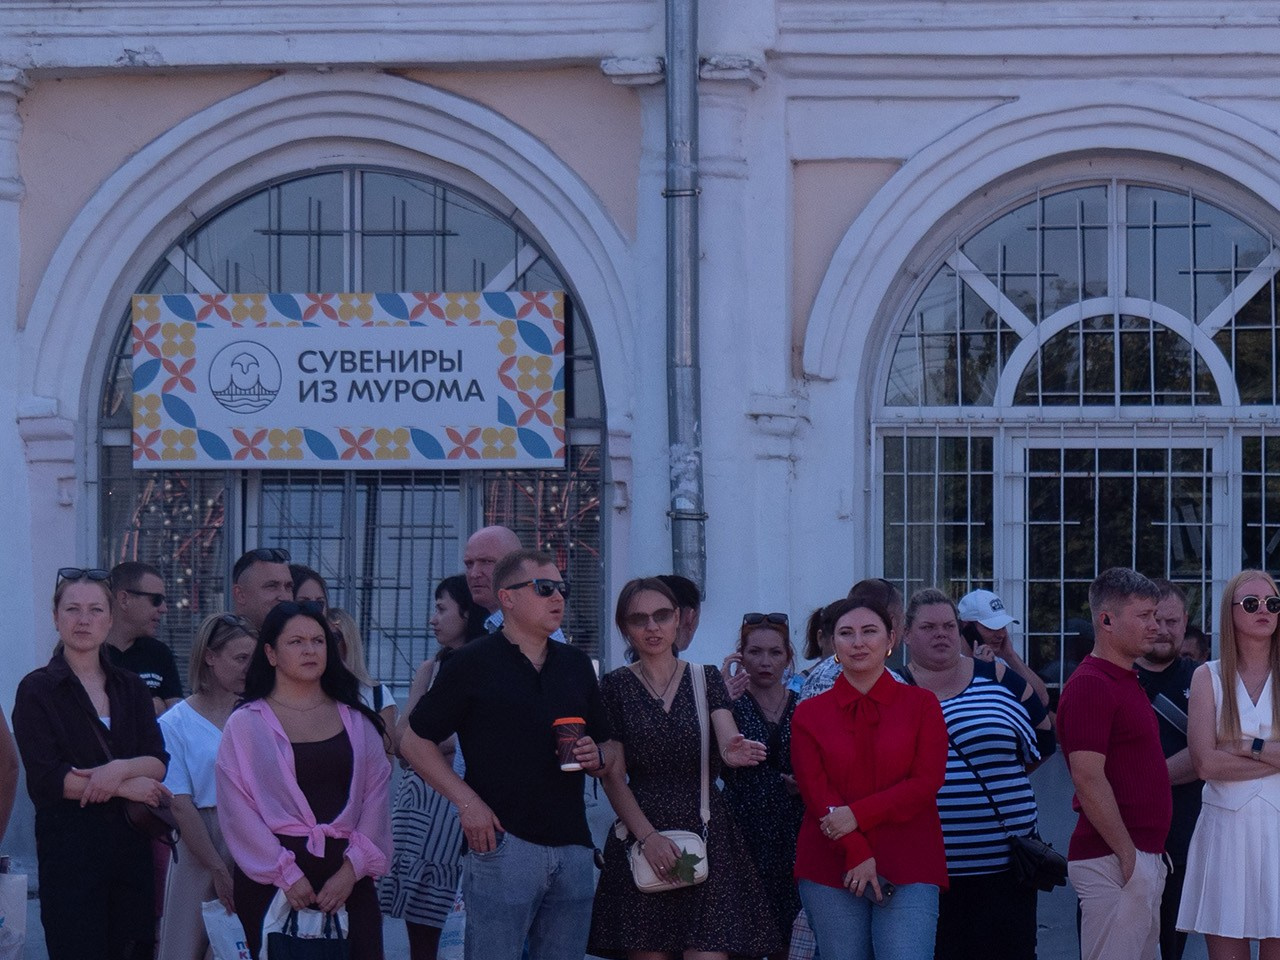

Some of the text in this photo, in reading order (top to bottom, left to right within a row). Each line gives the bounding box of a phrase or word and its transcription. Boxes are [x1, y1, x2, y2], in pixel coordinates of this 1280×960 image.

[298, 349, 463, 374] СУВЕНИРЫ
[299, 379, 486, 403] ИЗ МУРОМА
